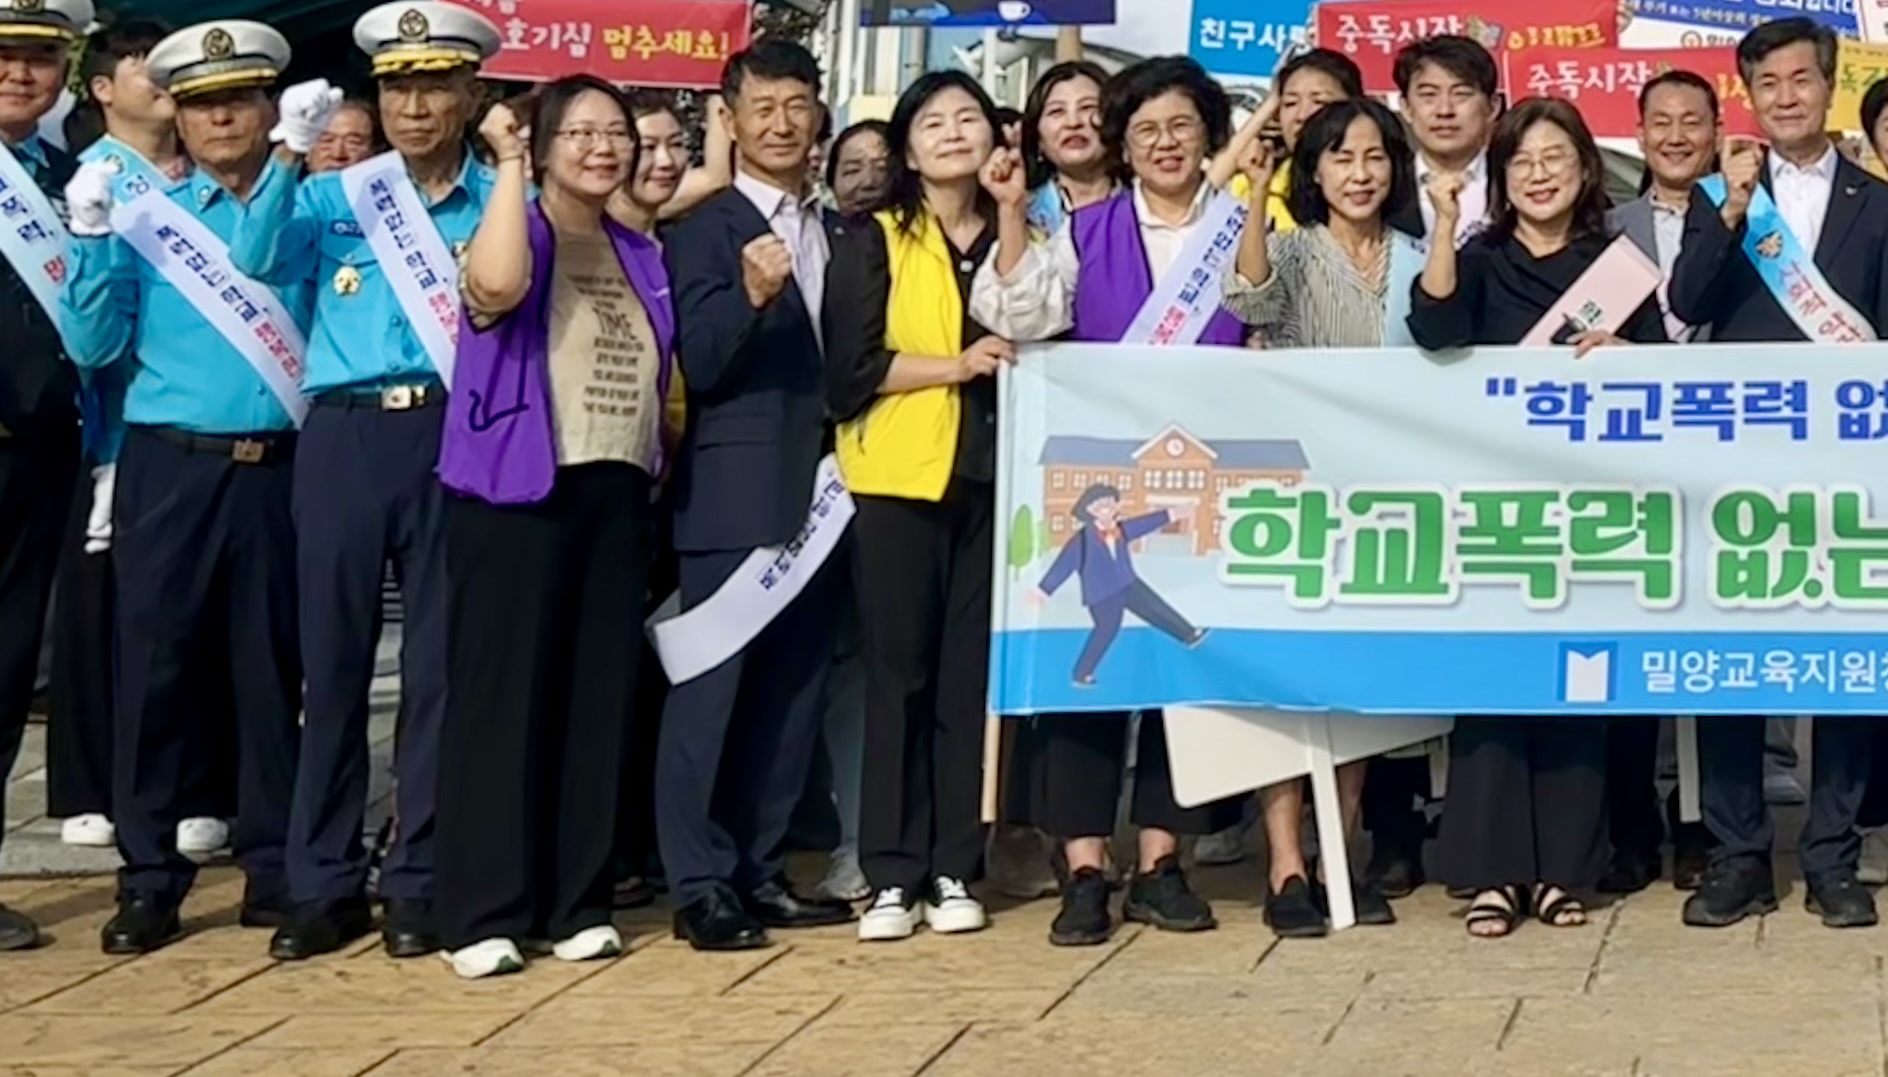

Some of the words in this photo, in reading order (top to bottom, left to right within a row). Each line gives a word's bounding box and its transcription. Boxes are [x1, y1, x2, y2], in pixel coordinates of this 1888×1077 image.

[501, 21, 592, 58] 호기심
[602, 25, 730, 61] 멈추세요!
[1224, 486, 1675, 602] 학교폭력
